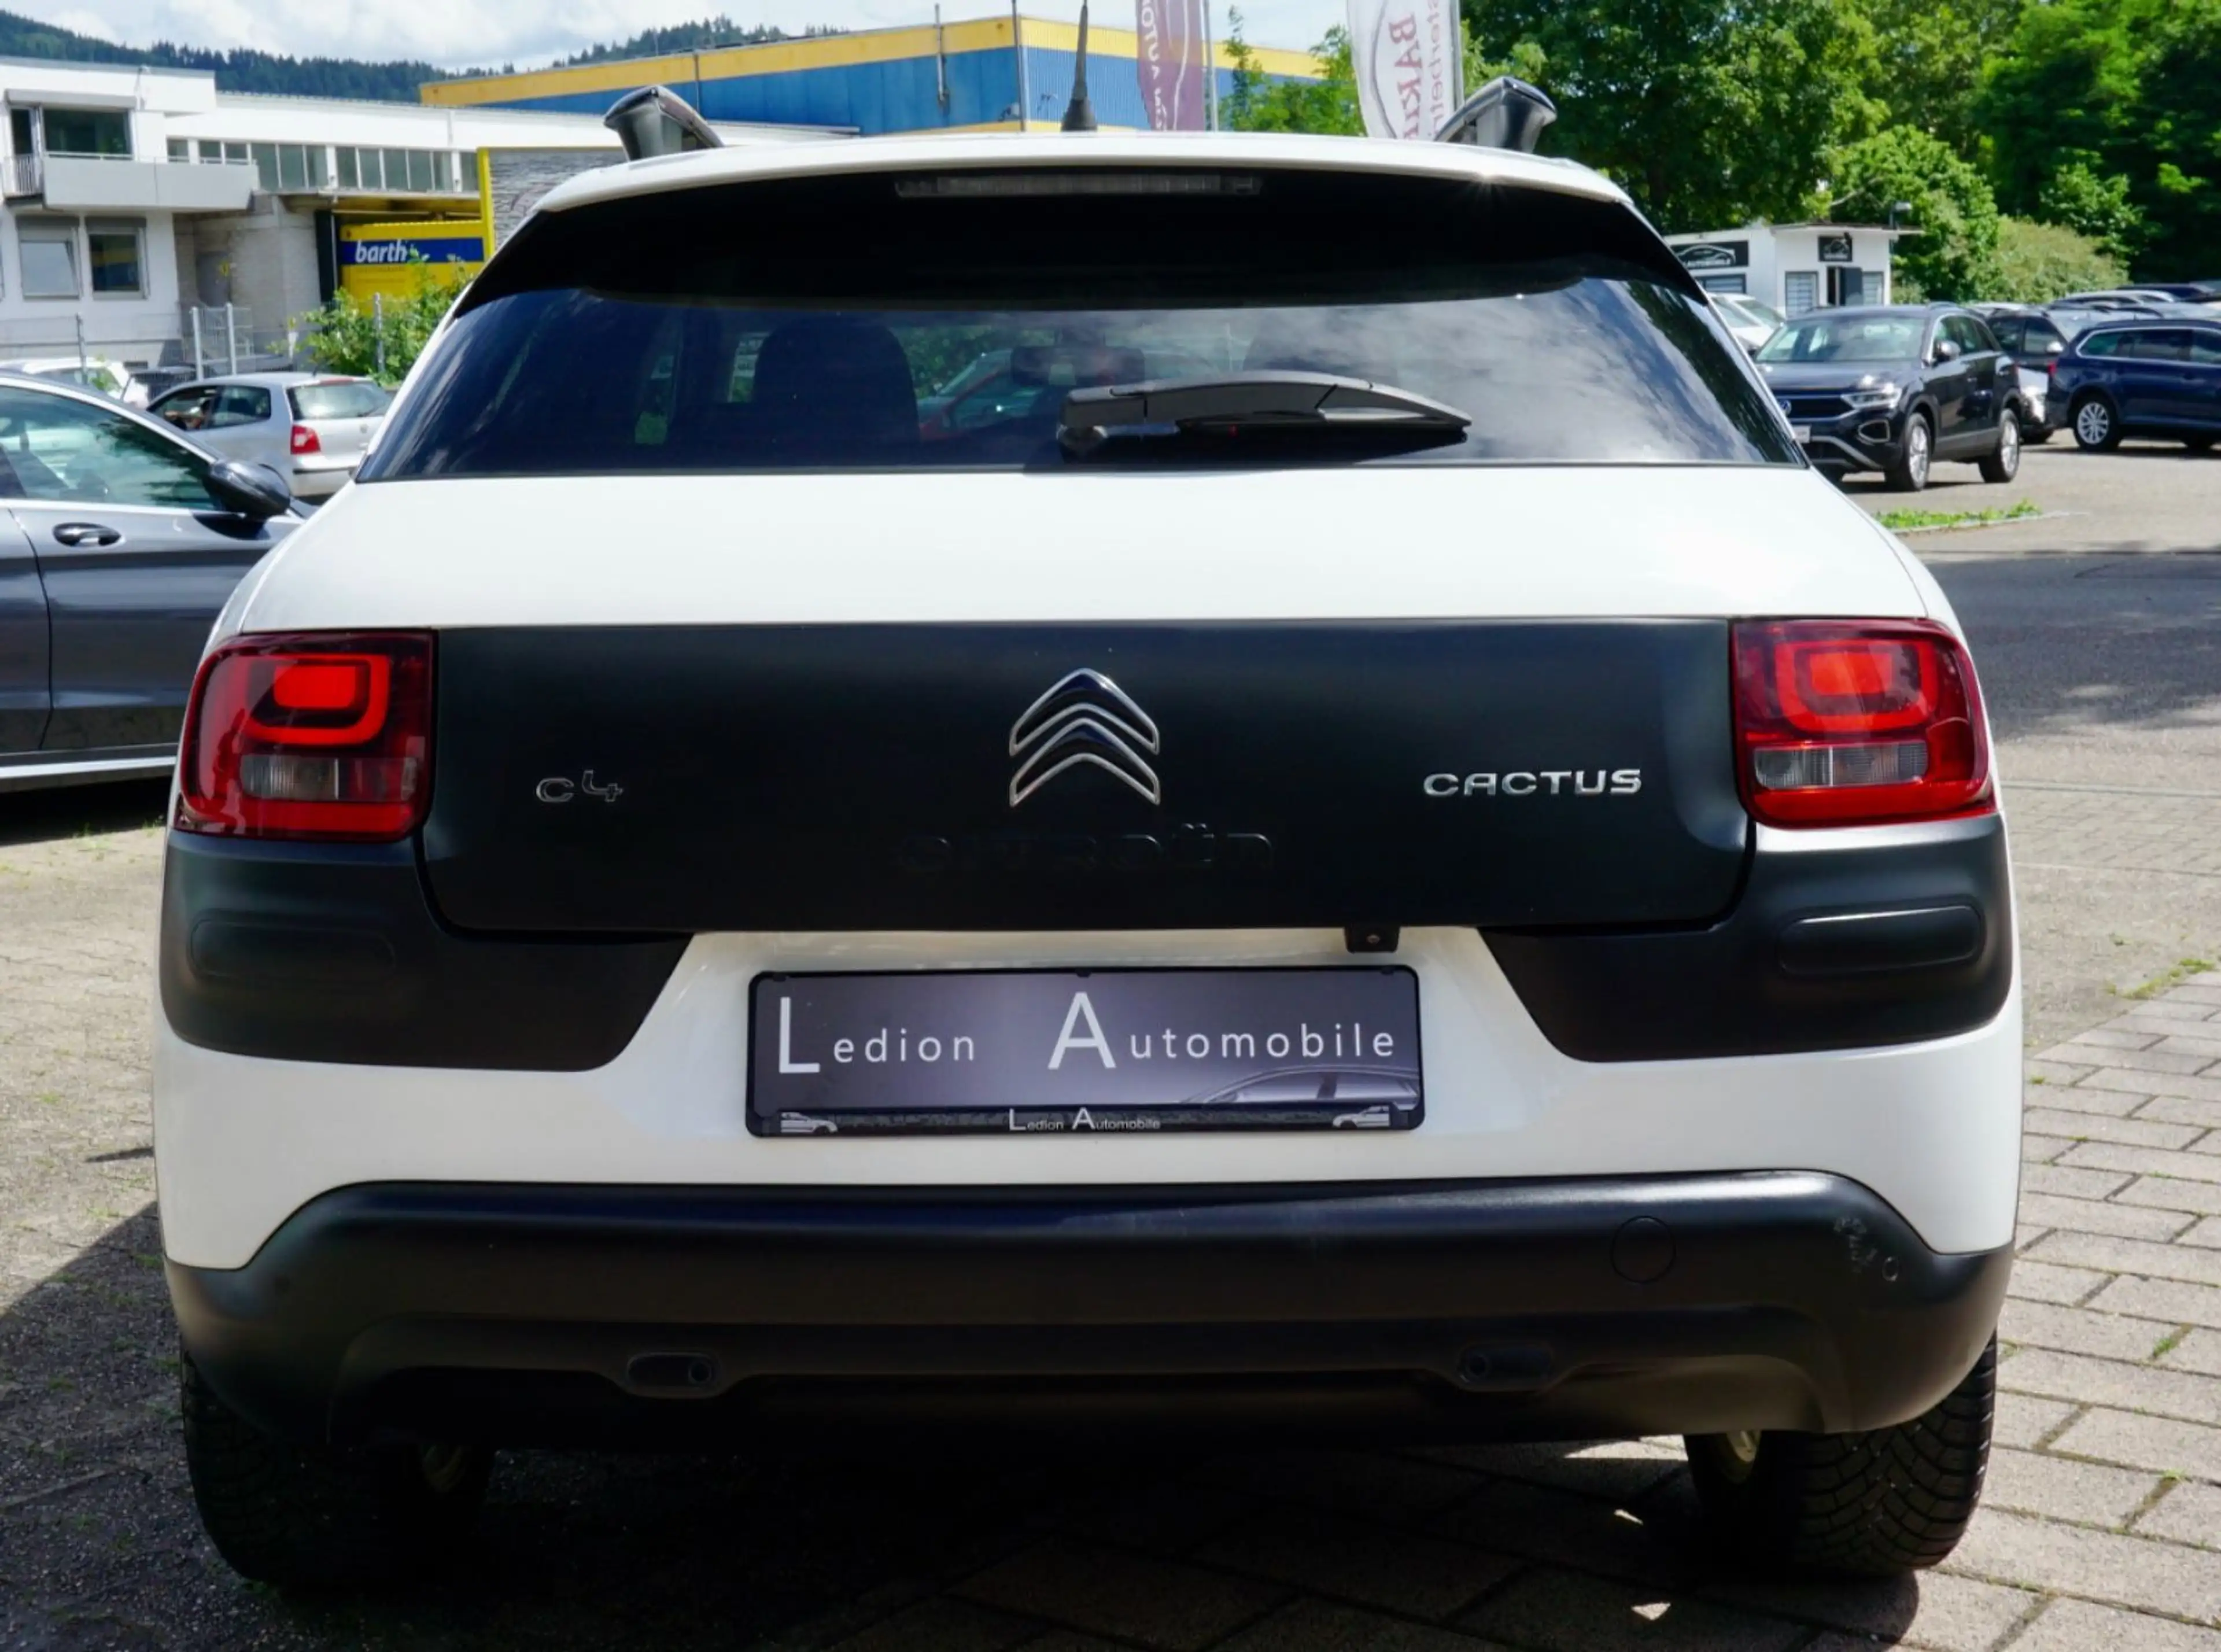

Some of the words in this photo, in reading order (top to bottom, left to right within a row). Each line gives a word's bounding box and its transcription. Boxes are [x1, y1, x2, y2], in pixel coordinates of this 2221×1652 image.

[355, 238, 407, 264] barth
[1422, 768, 1643, 797] CACTUS
[779, 996, 975, 1074] Ledion
[1047, 991, 1394, 1070] Automobile
[1009, 1108, 1064, 1131] Ledion
[1072, 1107, 1161, 1130] Automobile
